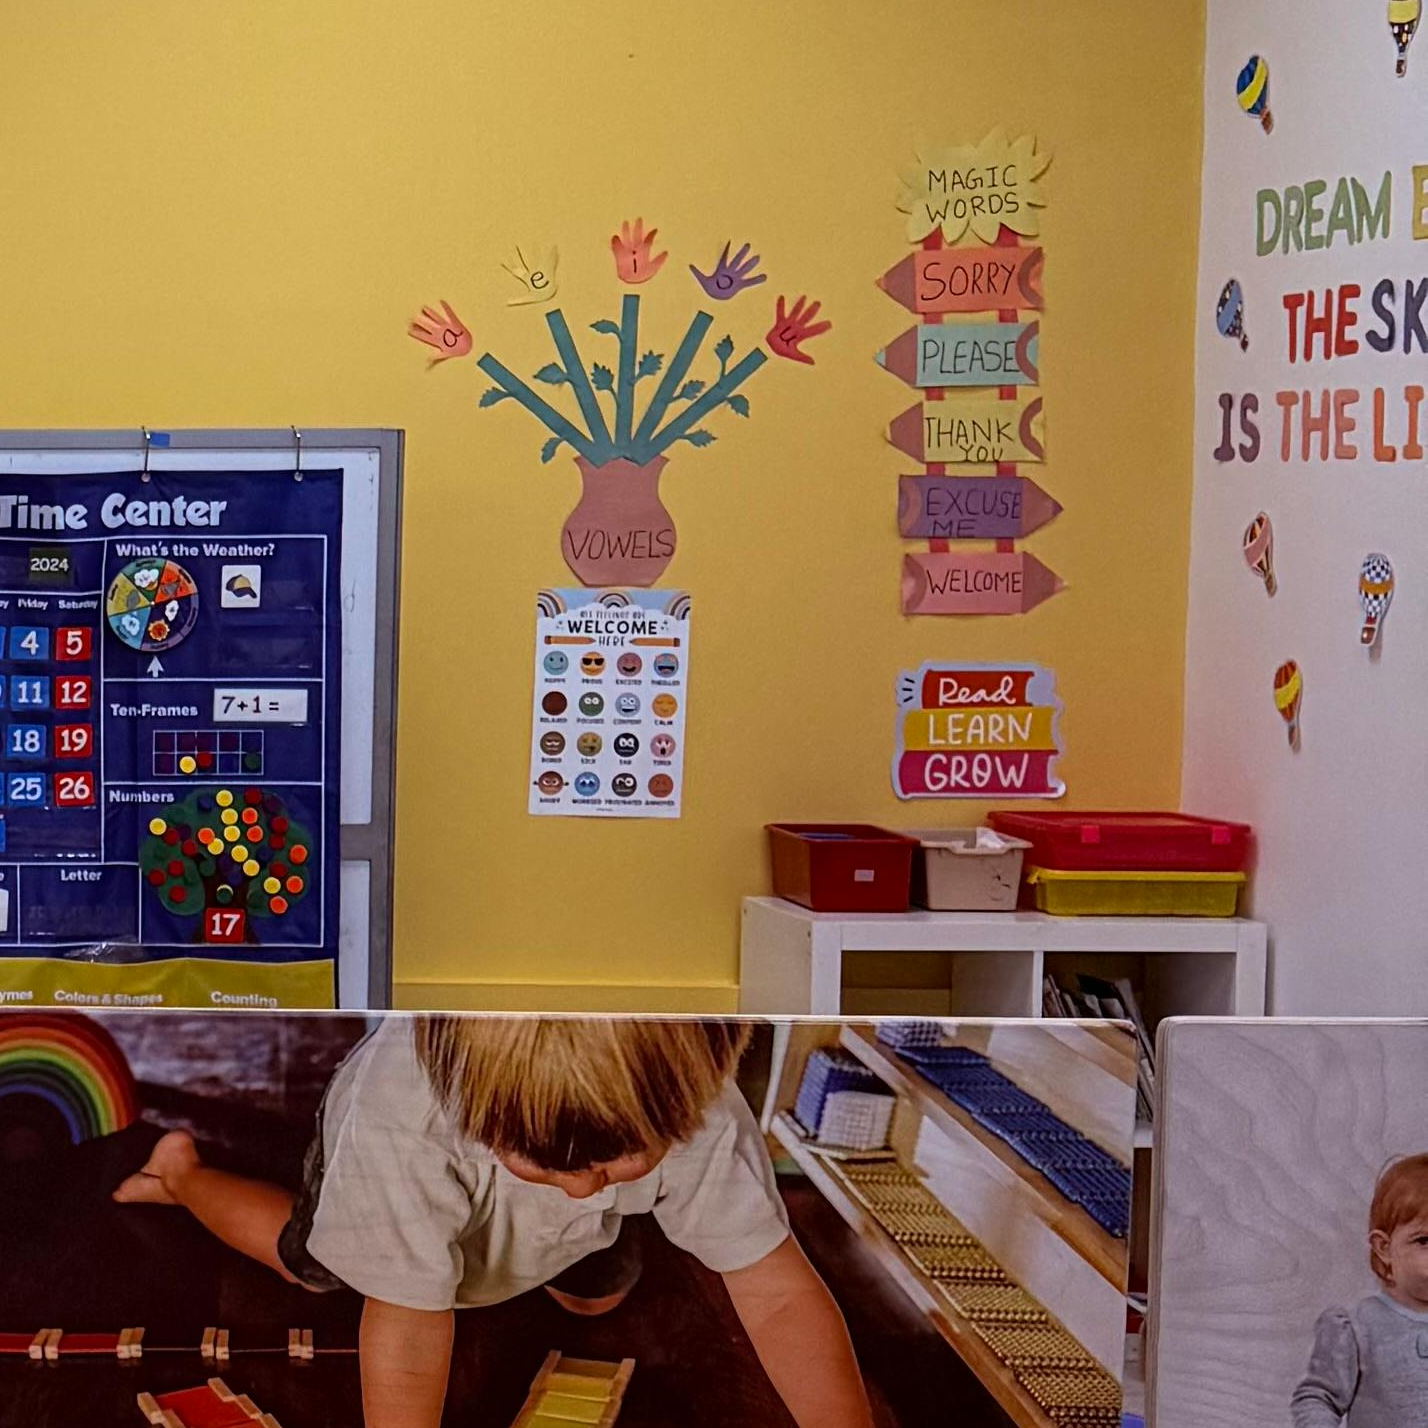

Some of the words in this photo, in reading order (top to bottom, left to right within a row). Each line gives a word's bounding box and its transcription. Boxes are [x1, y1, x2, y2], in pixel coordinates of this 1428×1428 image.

[928, 165, 1018, 193] MAGIC
[926, 192, 1019, 223] WORDS
[1256, 171, 1392, 256] DREAM
[632, 251, 637, 273] i
[530, 271, 549, 289] e
[716, 274, 733, 290] o
[921, 262, 1016, 301] SORRY
[1282, 283, 1361, 364] THE
[443, 329, 463, 347] a
[923, 339, 1021, 374] PLEASE
[926, 417, 1014, 448] THANK
[1214, 392, 1260, 463] IS
[1276, 388, 1360, 462] THE
[959, 445, 1003, 462] YOU
[101, 493, 227, 528] Center
[926, 487, 1021, 519] EXCUSE
[932, 519, 976, 538] ME
[116, 542, 169, 556] What's
[173, 544, 199, 556] the
[203, 544, 275, 556] Weather?
[567, 529, 675, 561] VOWELS
[30, 558, 69, 571] 2024
[926, 569, 1022, 595] WELCOME
[567, 620, 658, 635] WELCOME
[20, 630, 39, 654] 4
[66, 631, 83, 654] 5
[18, 681, 42, 703] 11
[62, 681, 87, 703] 12
[939, 675, 1016, 706] Read
[110, 704, 198, 717] Ten-Frames
[13, 729, 40, 752] 18
[61, 729, 87, 751] 19
[929, 712, 1032, 745] LEARN
[924, 752, 1029, 791] GROW
[11, 777, 42, 800] 25
[59, 776, 89, 799] 26
[109, 790, 175, 803] Numbers
[61, 870, 102, 882] Letter
[211, 914, 240, 936] 17
[210, 991, 278, 1008] Counting
